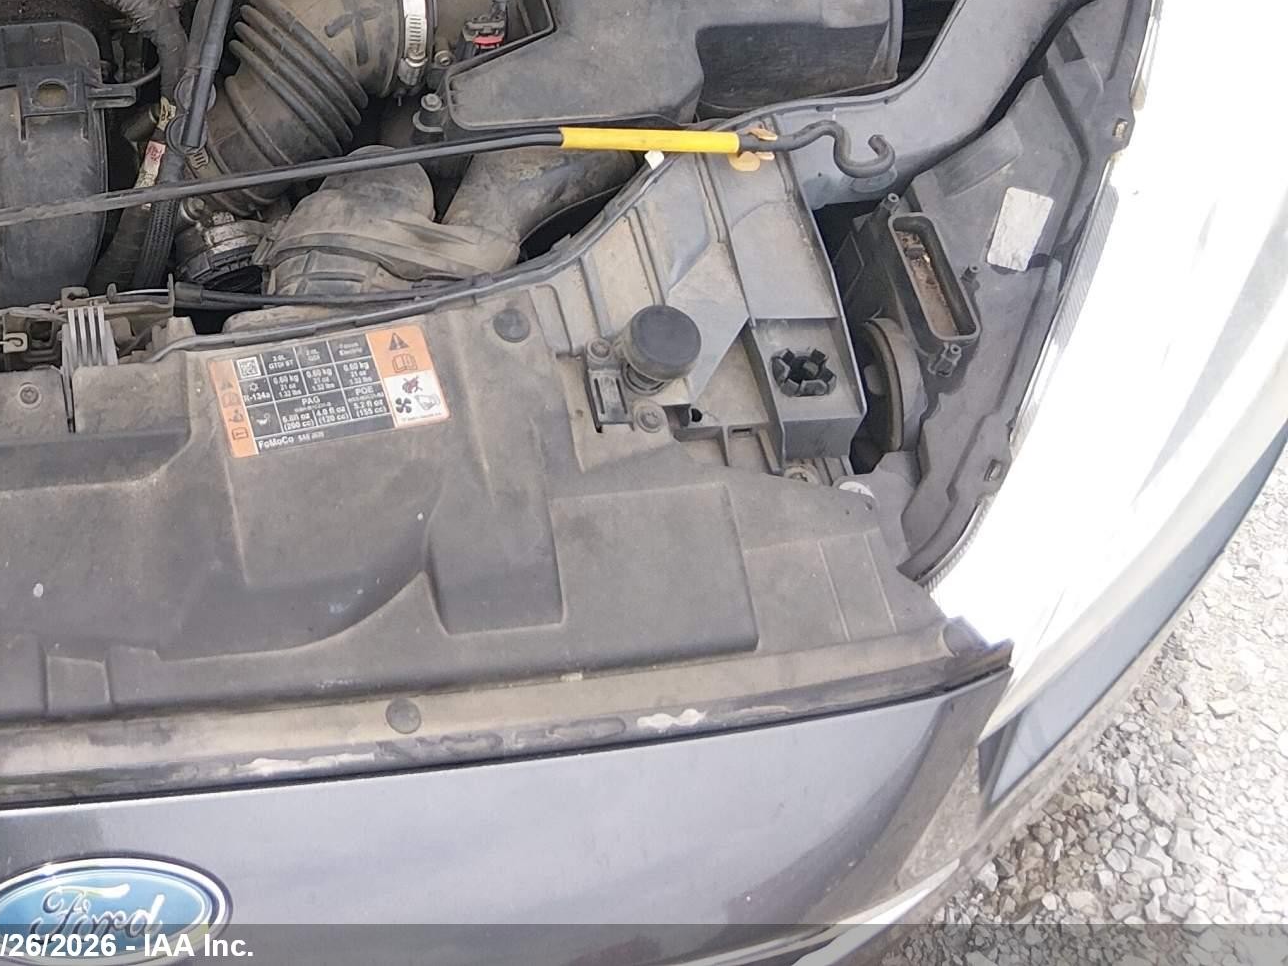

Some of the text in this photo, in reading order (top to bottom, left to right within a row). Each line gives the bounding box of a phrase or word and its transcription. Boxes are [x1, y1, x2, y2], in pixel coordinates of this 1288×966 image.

[354, 385, 373, 396] POE
[301, 395, 320, 406] PAG
[257, 434, 294, 449] FoMoCo
[30, 883, 166, 945] Ford
